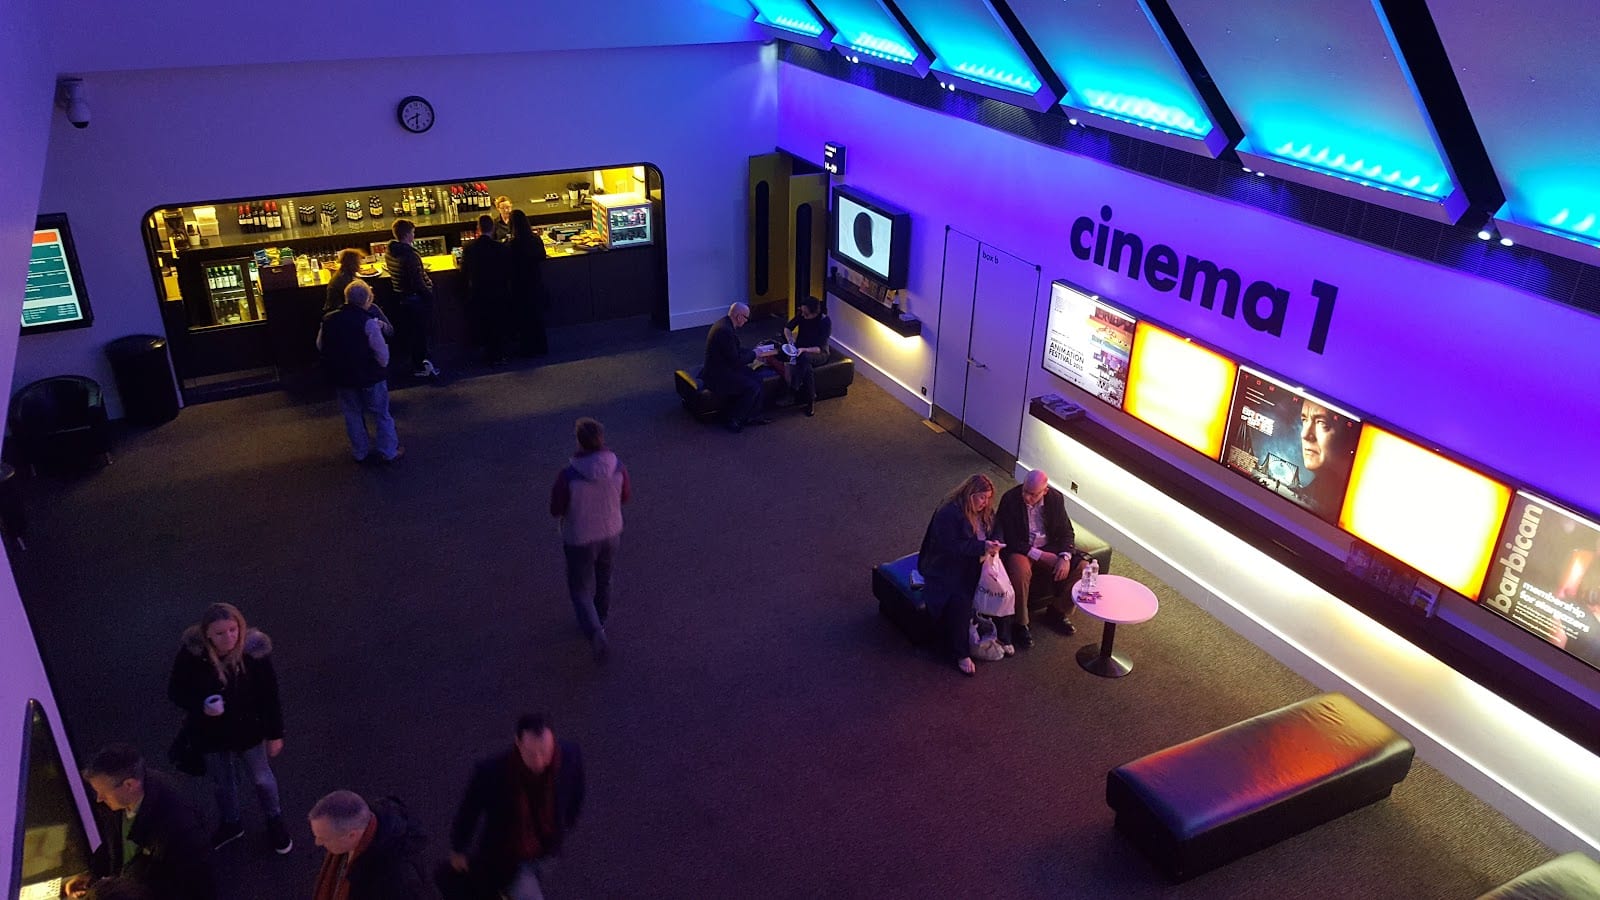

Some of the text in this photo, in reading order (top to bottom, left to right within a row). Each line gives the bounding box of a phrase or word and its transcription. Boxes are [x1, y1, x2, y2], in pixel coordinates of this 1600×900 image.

[982, 251, 999, 264] box b
[1070, 205, 1339, 355] cinema 1
[1049, 348, 1073, 366] FESTIVAL
[1050, 342, 1084, 364] ANIMATION
[1486, 504, 1543, 614] barbican
[1520, 590, 1536, 603] for
[1534, 599, 1590, 633] stargazers
[1522, 582, 1585, 618] membership
